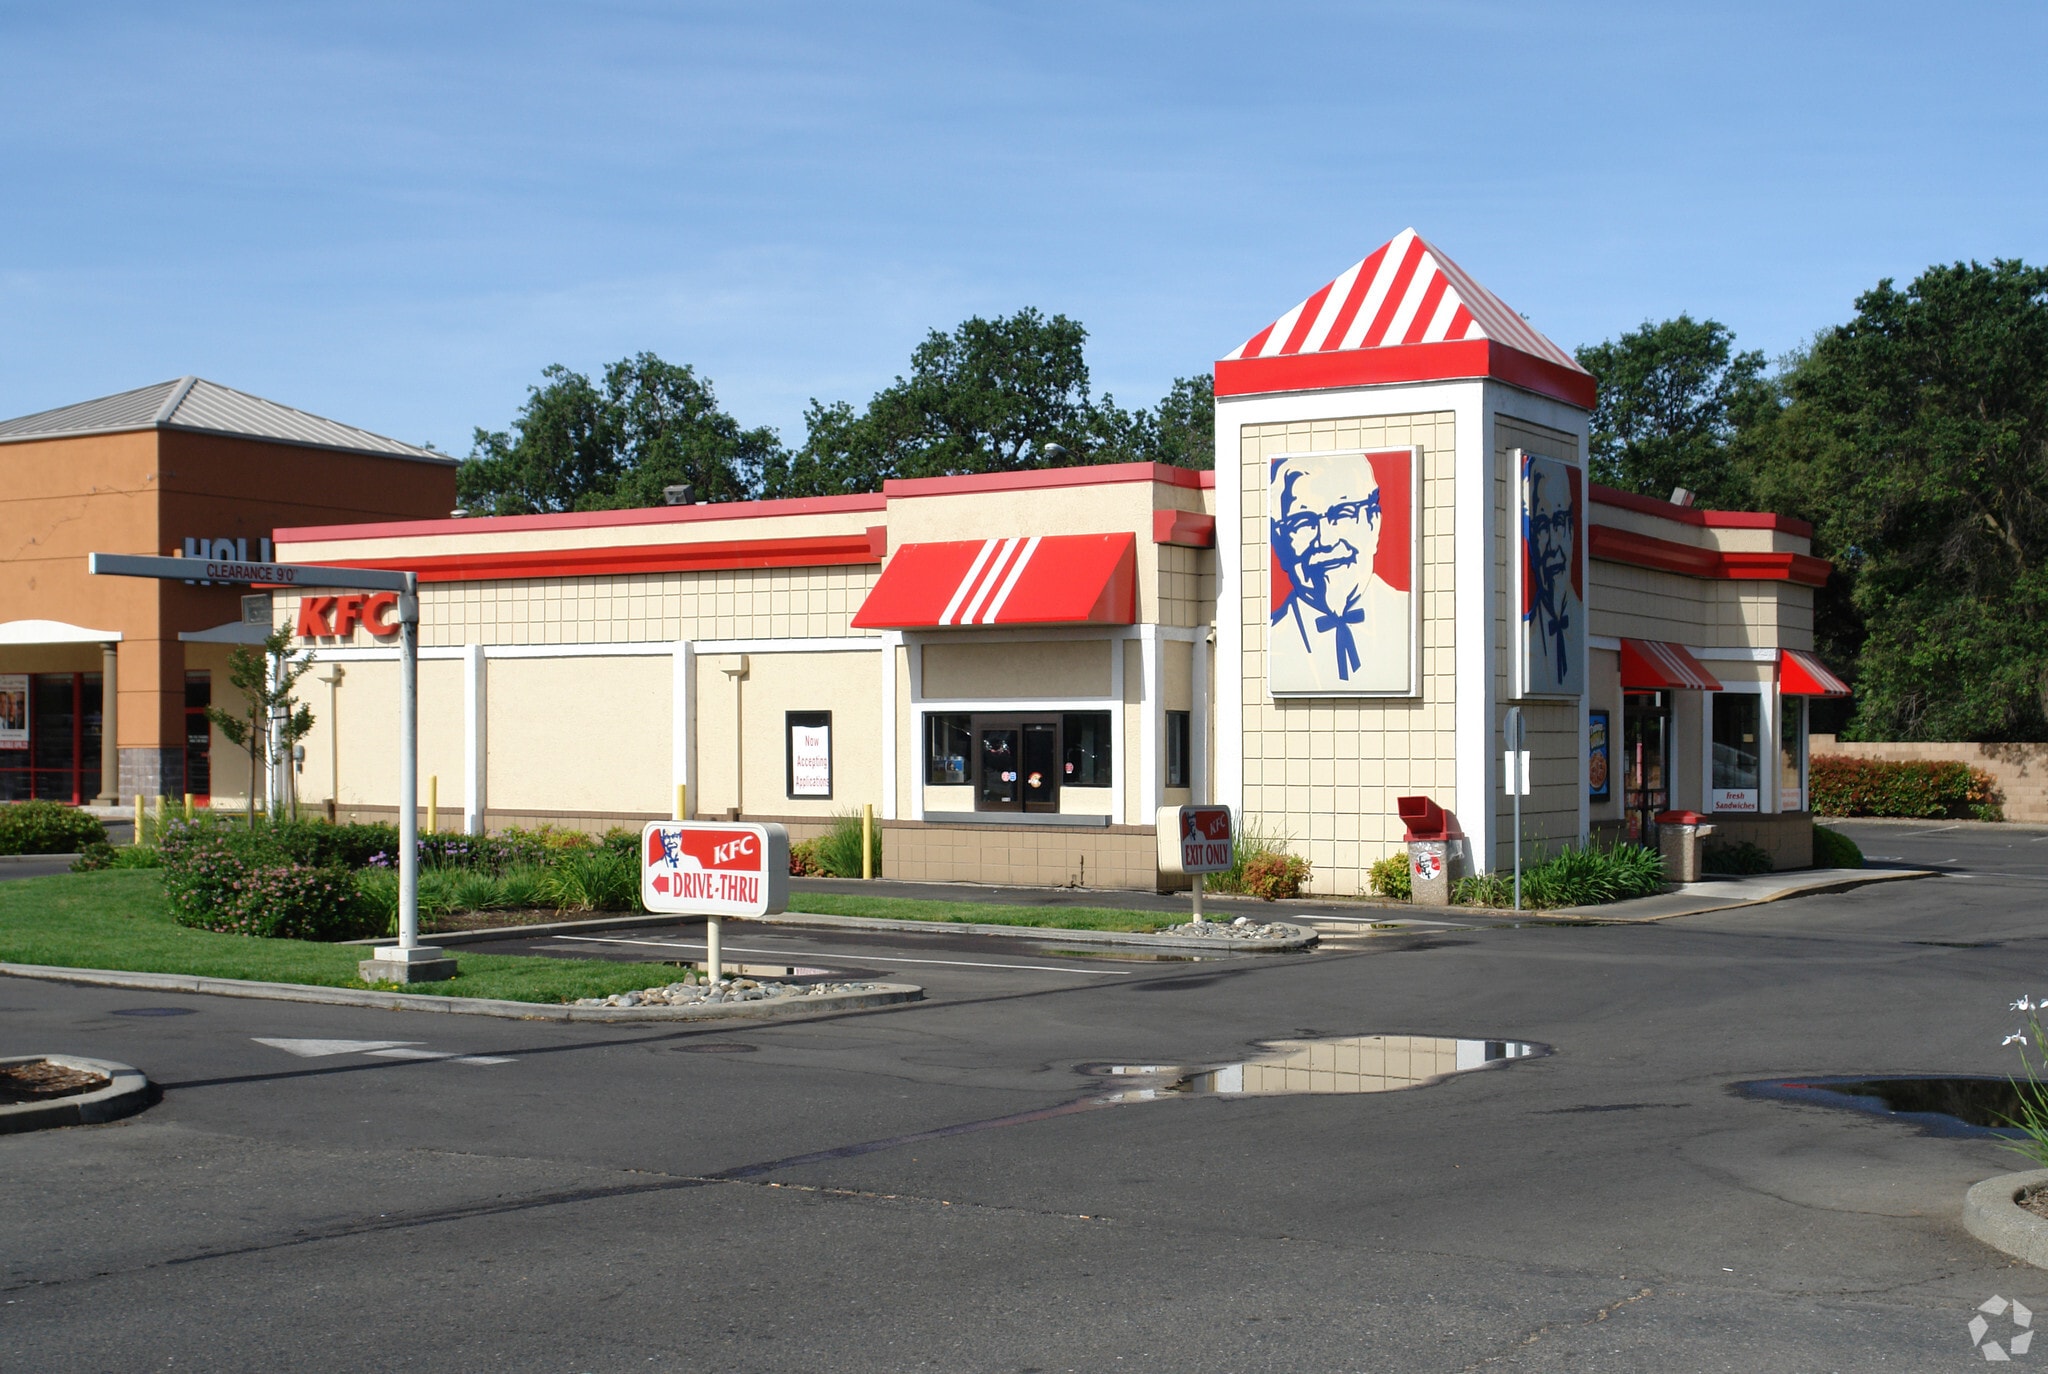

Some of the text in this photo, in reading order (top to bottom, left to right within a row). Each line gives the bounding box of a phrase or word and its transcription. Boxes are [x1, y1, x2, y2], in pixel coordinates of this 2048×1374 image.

[207, 564, 272, 580] CLEARANCE
[297, 591, 400, 637] KFC
[805, 735, 819, 746] Now
[797, 755, 828, 769] Accepting
[1715, 801, 1755, 809] Sandwiches
[1210, 814, 1226, 835] KFC
[713, 835, 754, 865] KFC
[1185, 844, 1228, 865] EXIT ONLY
[673, 872, 759, 903] DRIVE-THRU
